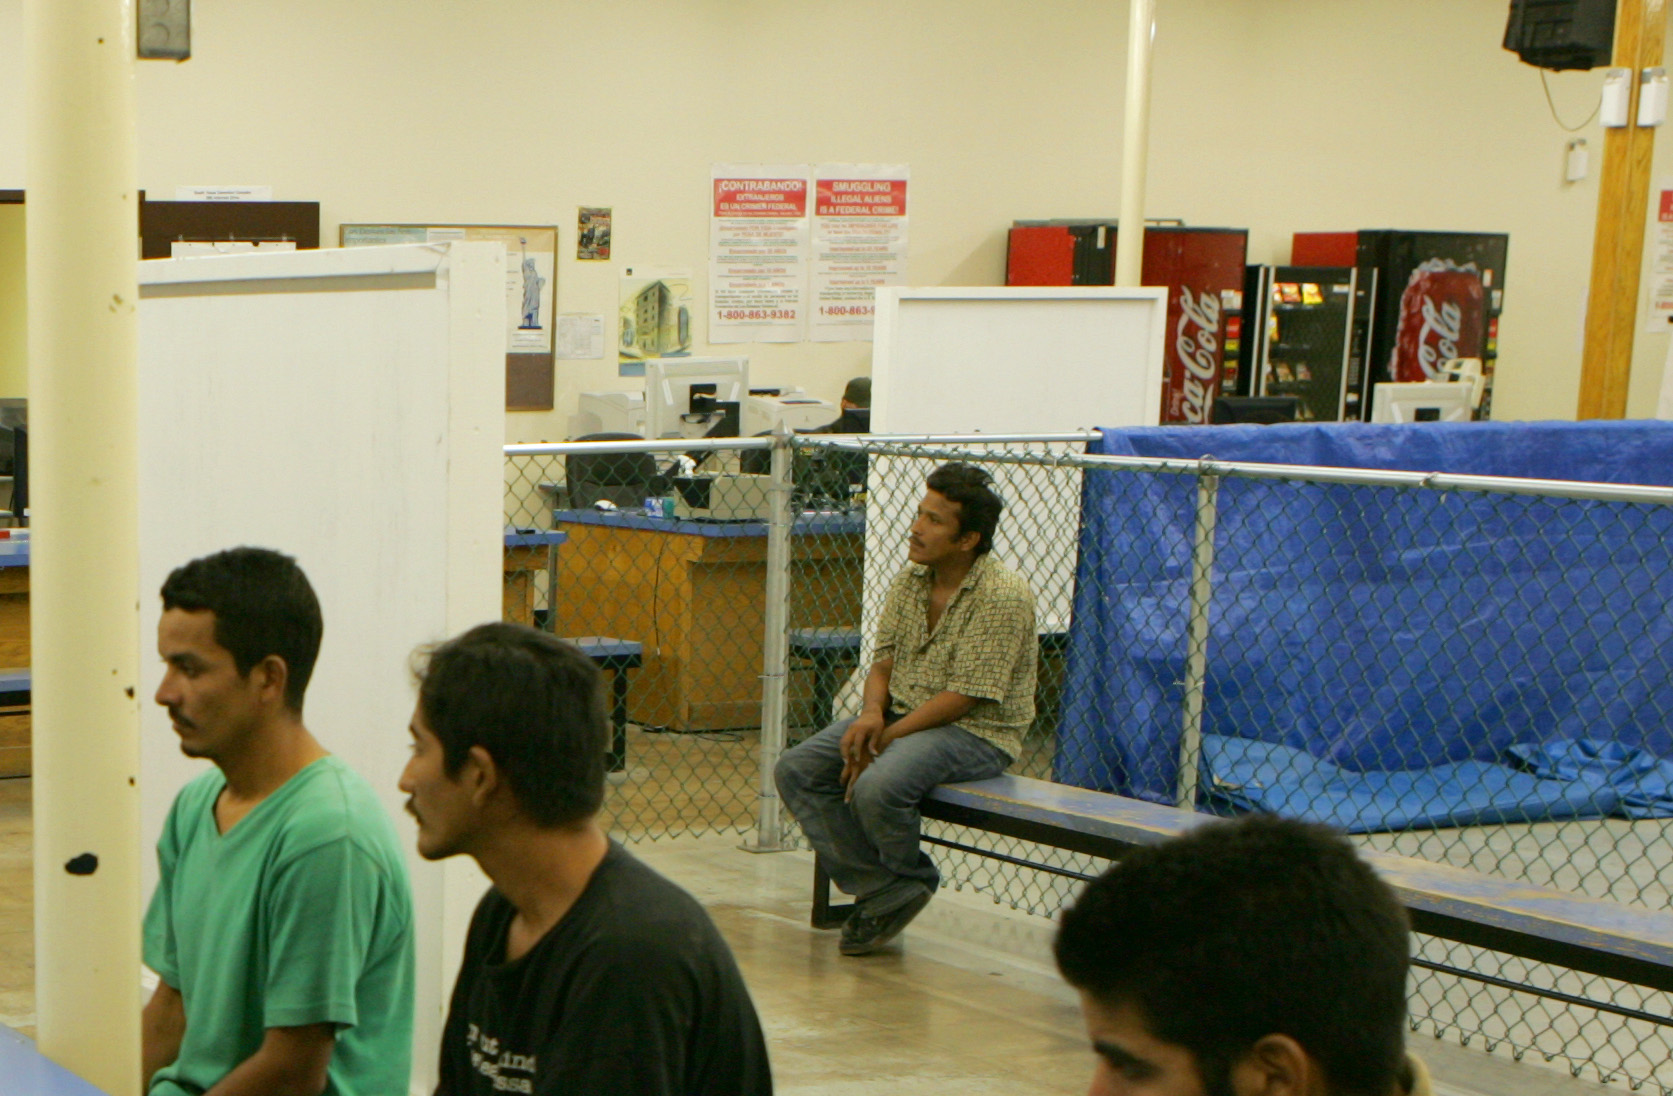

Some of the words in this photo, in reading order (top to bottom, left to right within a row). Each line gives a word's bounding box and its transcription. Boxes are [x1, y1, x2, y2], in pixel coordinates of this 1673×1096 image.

[719, 180, 802, 193] ¡CONTRABANDO!
[832, 181, 891, 192] SMUGGLING
[830, 194, 862, 203] ILLEGAL
[863, 194, 892, 203] ALIENS
[828, 205, 835, 214] A
[835, 205, 871, 214] FEDERAL
[717, 310, 796, 320] 1-800-863-9382
